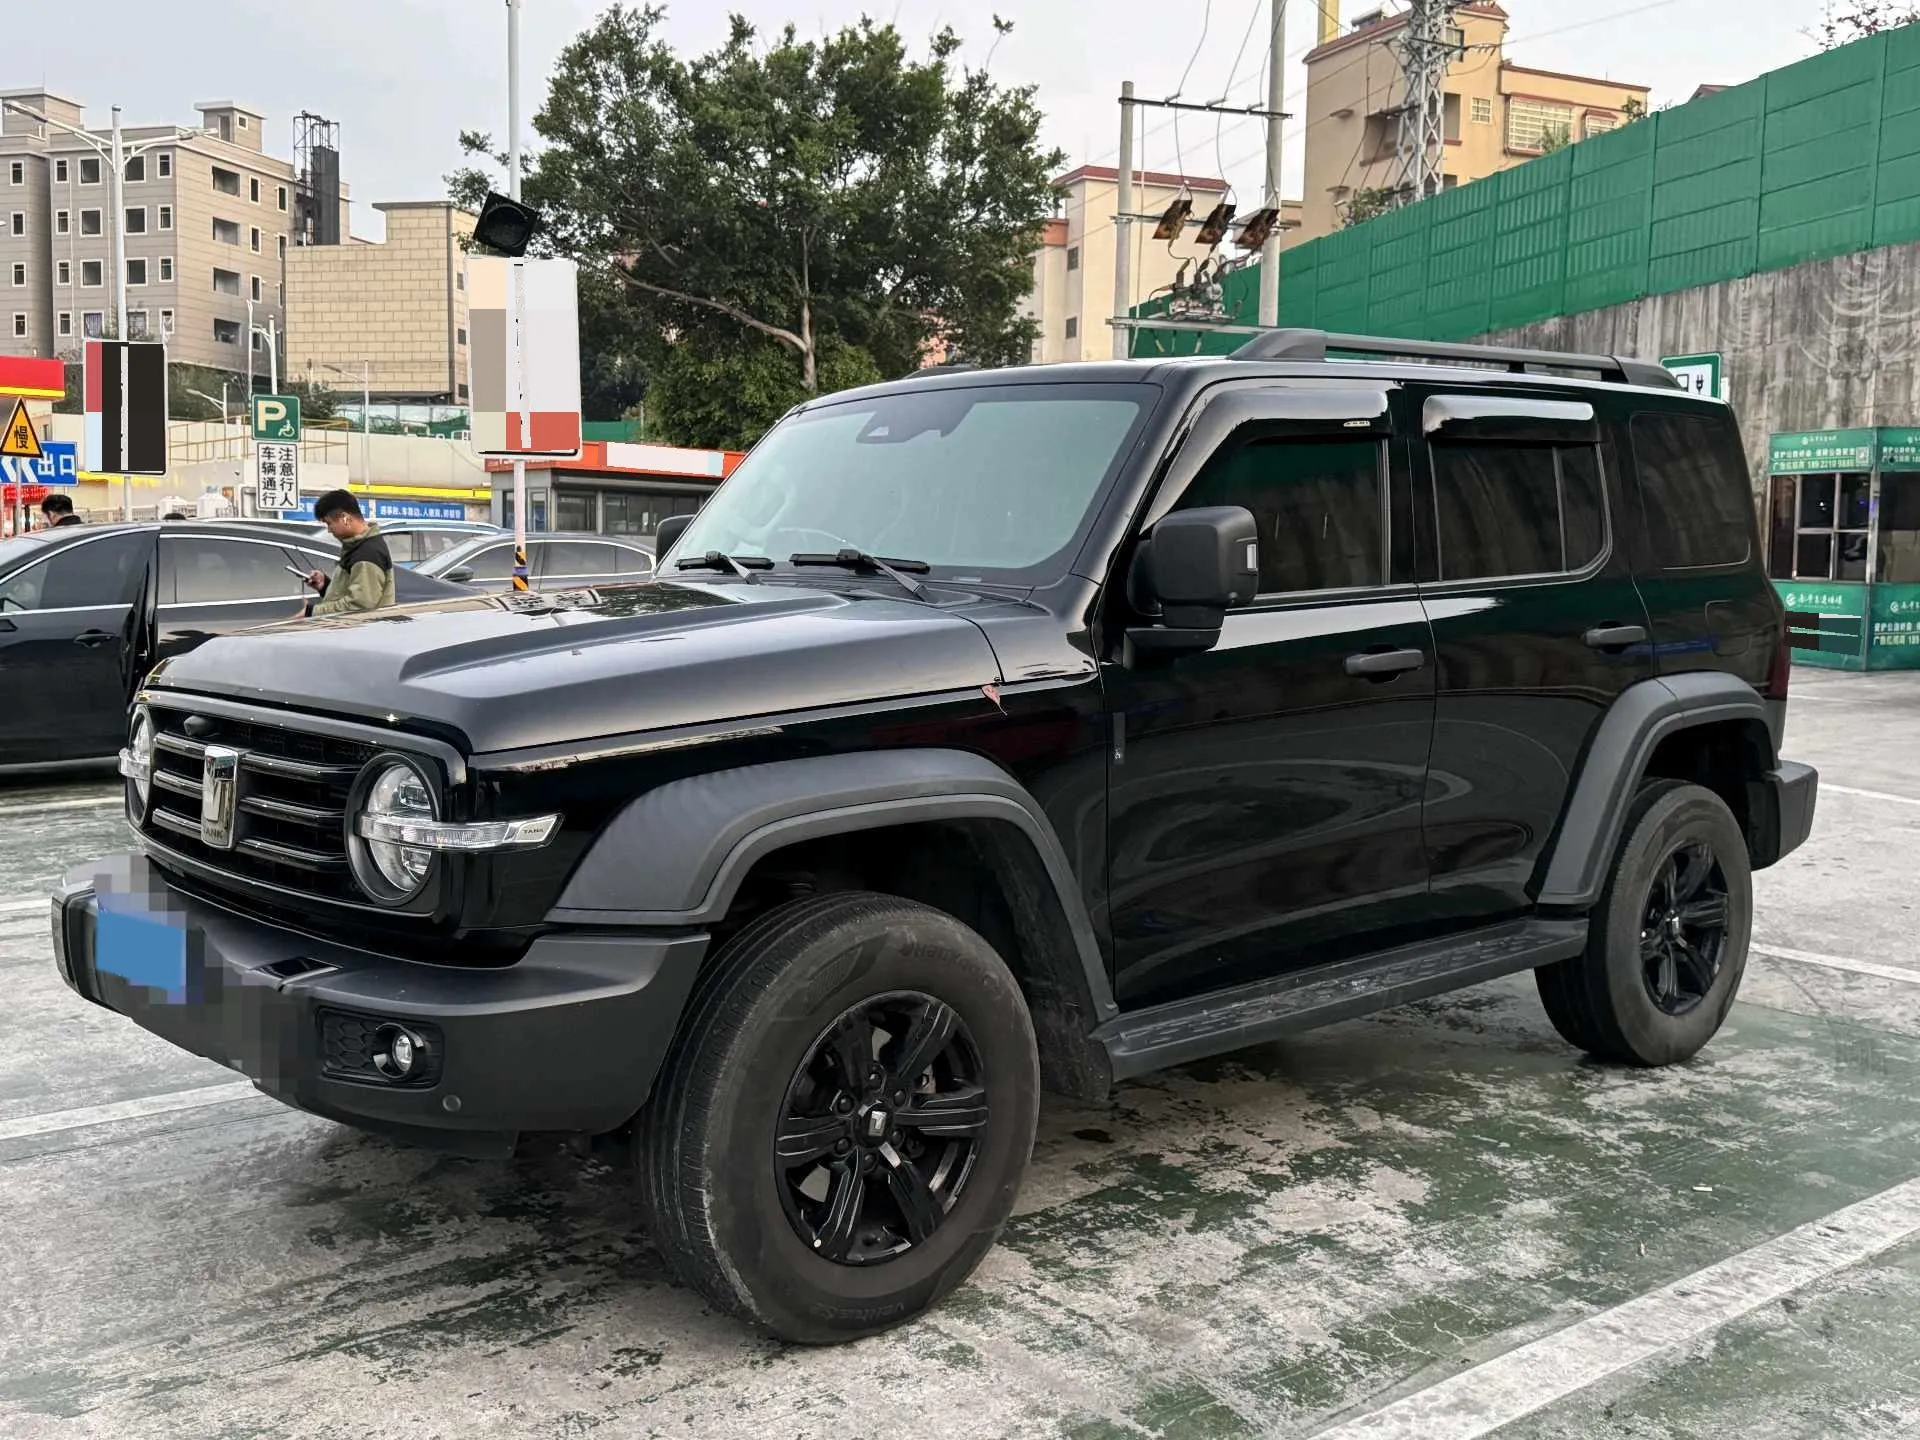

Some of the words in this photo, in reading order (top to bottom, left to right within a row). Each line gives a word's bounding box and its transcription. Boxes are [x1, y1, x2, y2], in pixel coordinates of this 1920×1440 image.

[257, 399, 287, 432] P
[14, 425, 29, 449] 慢
[37, 450, 76, 477] 出口
[261, 446, 277, 506] 车辆通行
[279, 447, 294, 507] 注意行人
